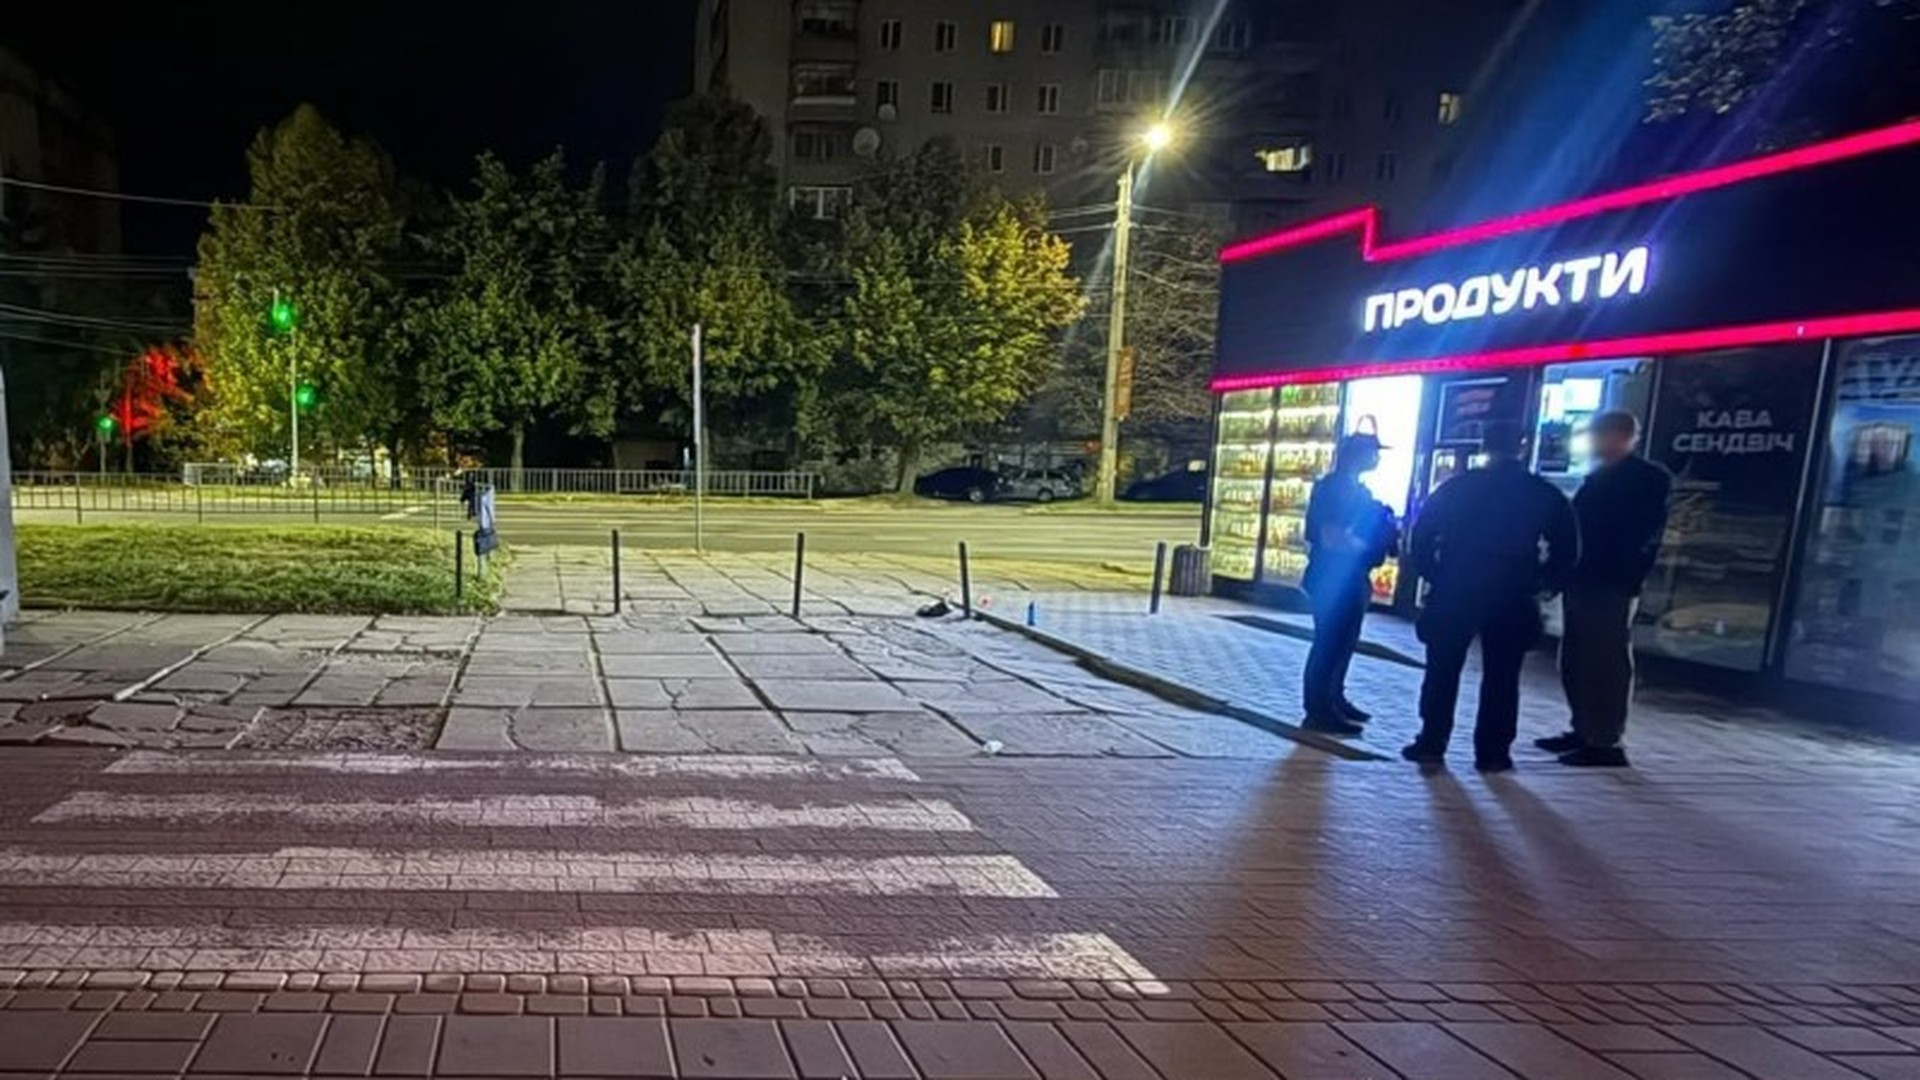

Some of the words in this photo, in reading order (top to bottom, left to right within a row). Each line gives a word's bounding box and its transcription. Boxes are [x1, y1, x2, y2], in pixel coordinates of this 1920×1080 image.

[1364, 246, 1649, 332] ПРОДУКТИ
[1696, 409, 1773, 429] КАВА
[1672, 432, 1795, 455] СЕНДВІЧ
